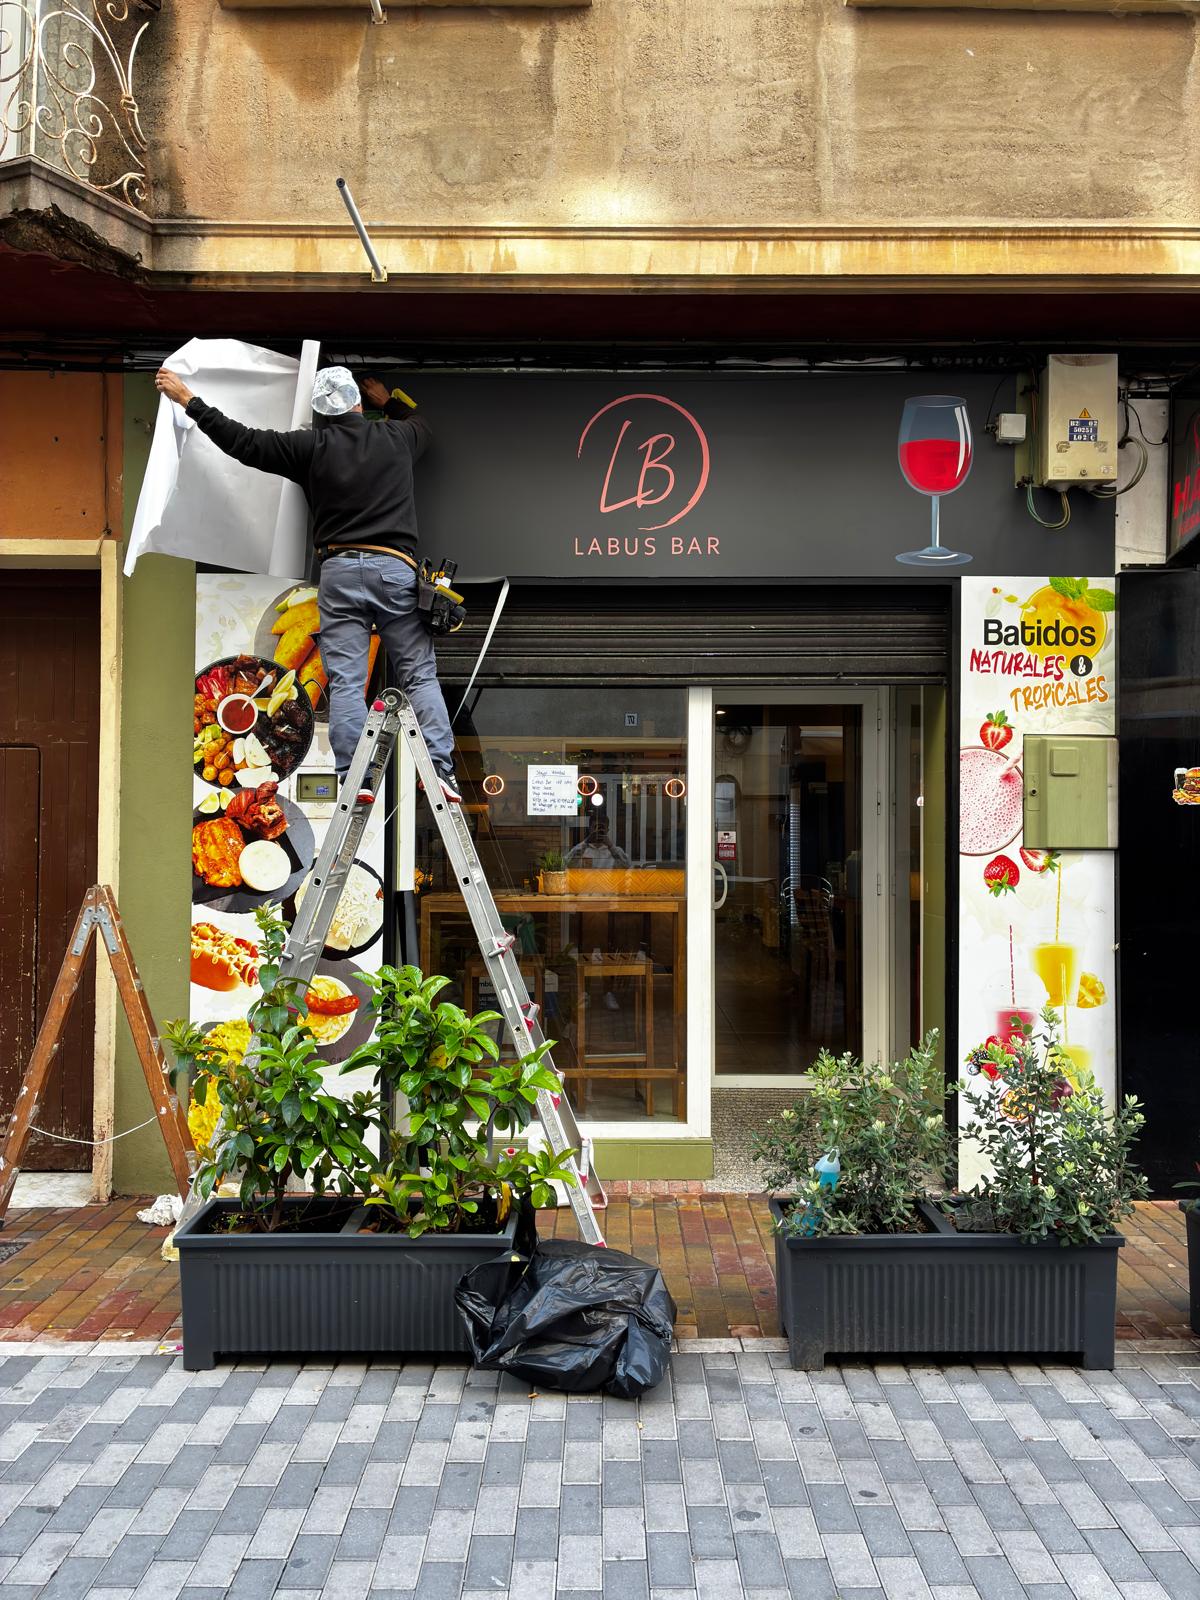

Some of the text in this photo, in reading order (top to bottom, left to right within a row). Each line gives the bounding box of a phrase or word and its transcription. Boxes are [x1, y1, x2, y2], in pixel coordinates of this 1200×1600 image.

[575, 537, 720, 556] LABUS BAR
[983, 619, 1096, 647] Batidos
[969, 648, 1065, 682] NATURALES
